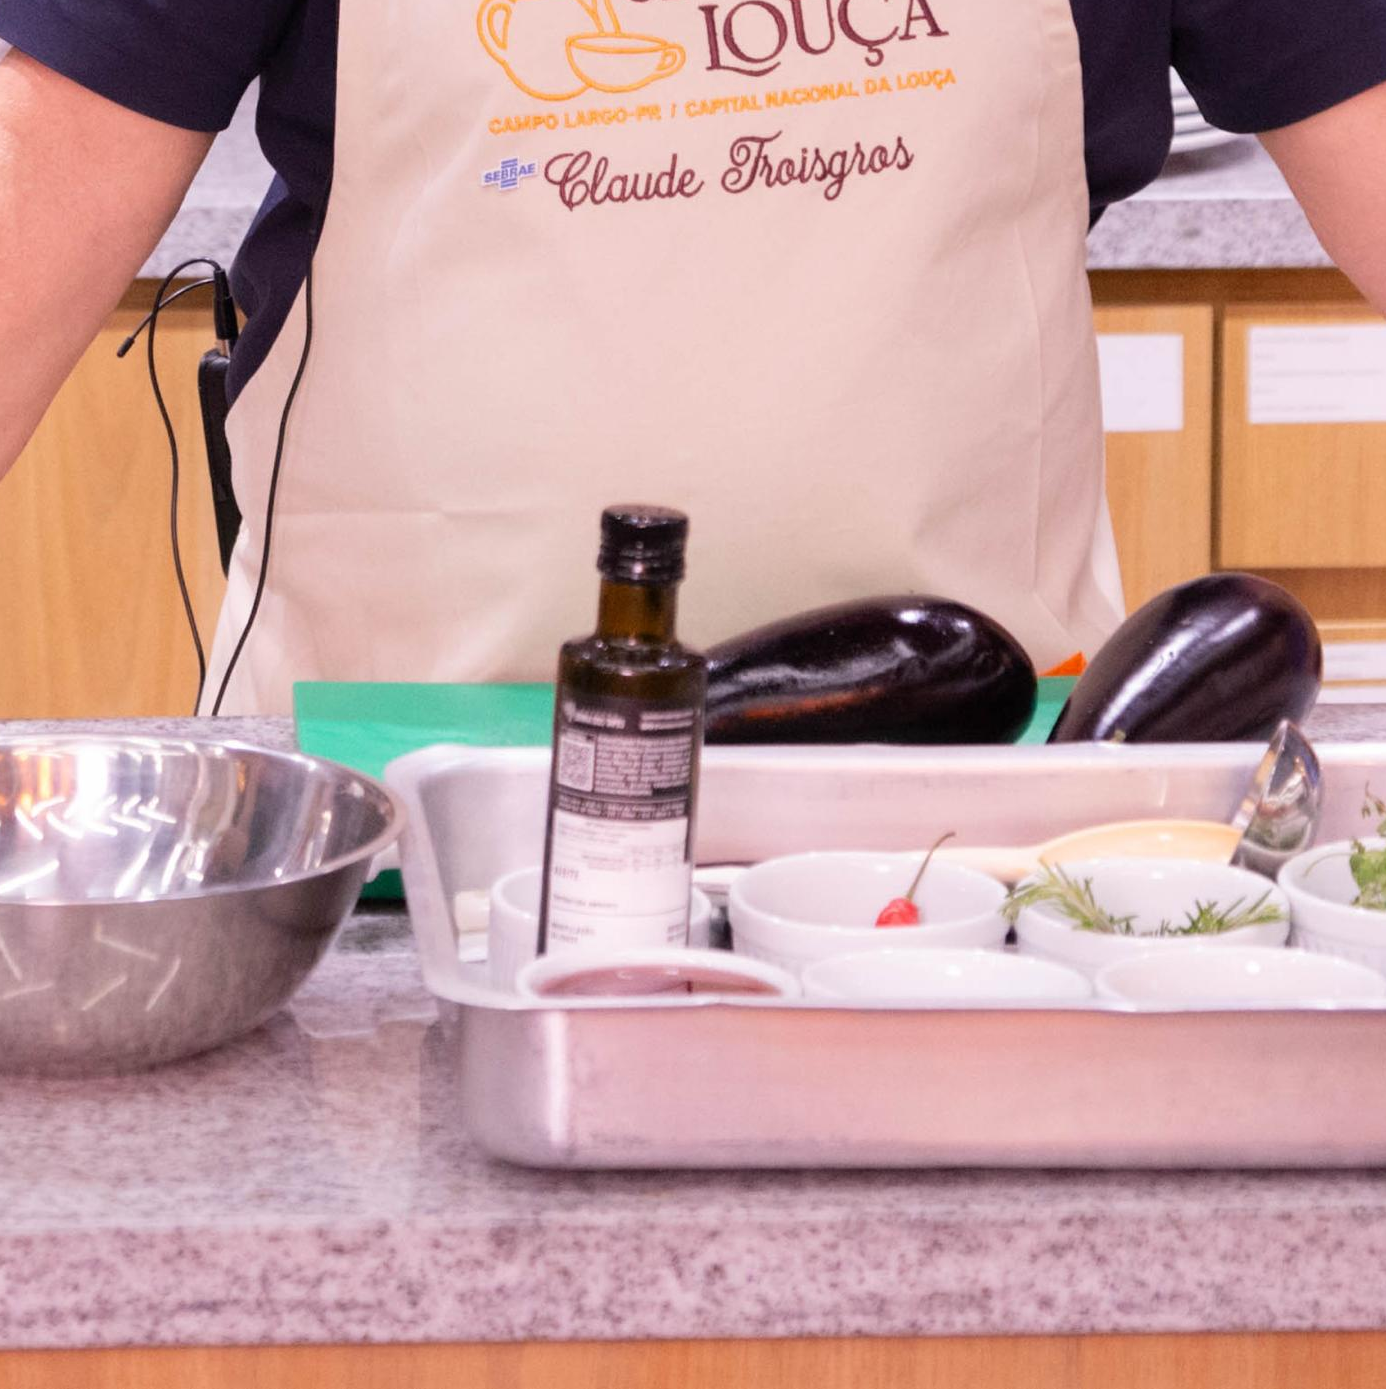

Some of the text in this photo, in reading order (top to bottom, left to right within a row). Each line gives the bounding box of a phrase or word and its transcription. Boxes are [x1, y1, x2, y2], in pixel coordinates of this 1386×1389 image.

[488, 112, 559, 135] CAMPO
[564, 103, 662, 129] LARGO-PR
[684, 94, 762, 118] CAPITAL
[765, 81, 860, 109] NACIONAL
[864, 76, 893, 95] DA
[896, 68, 957, 91] LOUÇA
[484, 162, 536, 183] SEBRAE
[543, 130, 915, 212] Claude Troisgros
